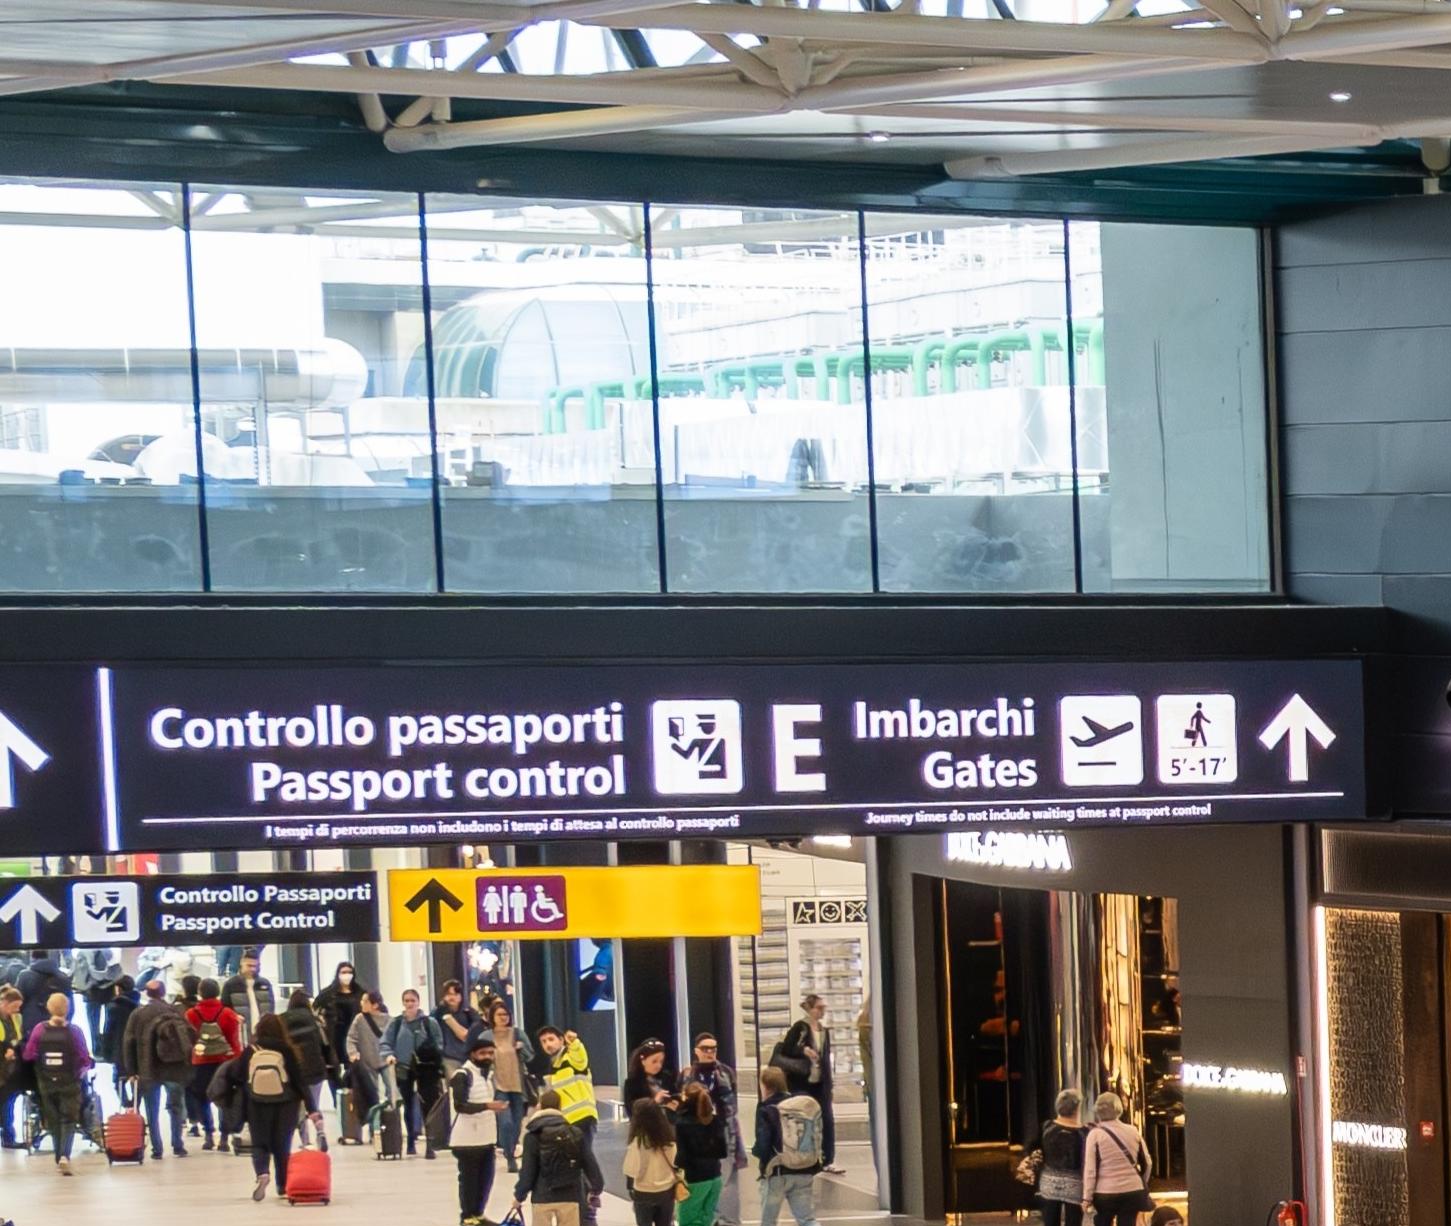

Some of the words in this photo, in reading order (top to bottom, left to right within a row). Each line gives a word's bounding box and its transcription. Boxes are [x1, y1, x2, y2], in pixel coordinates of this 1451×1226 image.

[152, 705, 373, 748] Controllo
[390, 702, 623, 755] passaporti
[856, 698, 1034, 738] Imbarchi
[773, 705, 825, 791] E
[253, 763, 453, 810] Passport
[466, 755, 625, 797] control
[924, 752, 1037, 788] Gates
[266, 825, 272, 838] I
[274, 824, 314, 840] tempi
[315, 824, 329, 836] di
[331, 821, 408, 838] percorrenza
[410, 825, 436, 834] non
[438, 820, 502, 833] includono
[503, 820, 509, 832] i
[511, 819, 548, 834] tempi
[550, 818, 563, 831] di
[565, 820, 603, 831] attesa
[604, 817, 617, 829] al
[619, 816, 674, 829] controllo
[676, 815, 739, 831] passaporti
[866, 812, 914, 825] Journey
[915, 811, 947, 822] times
[949, 810, 965, 821] do
[968, 811, 988, 821] not
[990, 808, 1031, 821] include
[1032, 807, 1075, 822] waiting
[1077, 807, 1107, 818] times
[1109, 807, 1121, 817] at
[1123, 806, 1170, 820] passport
[1172, 803, 1211, 816] control
[161, 886, 258, 903] Controllo
[265, 884, 370, 904] Passaporti
[162, 915, 252, 934] Passport
[257, 911, 334, 928] Control
